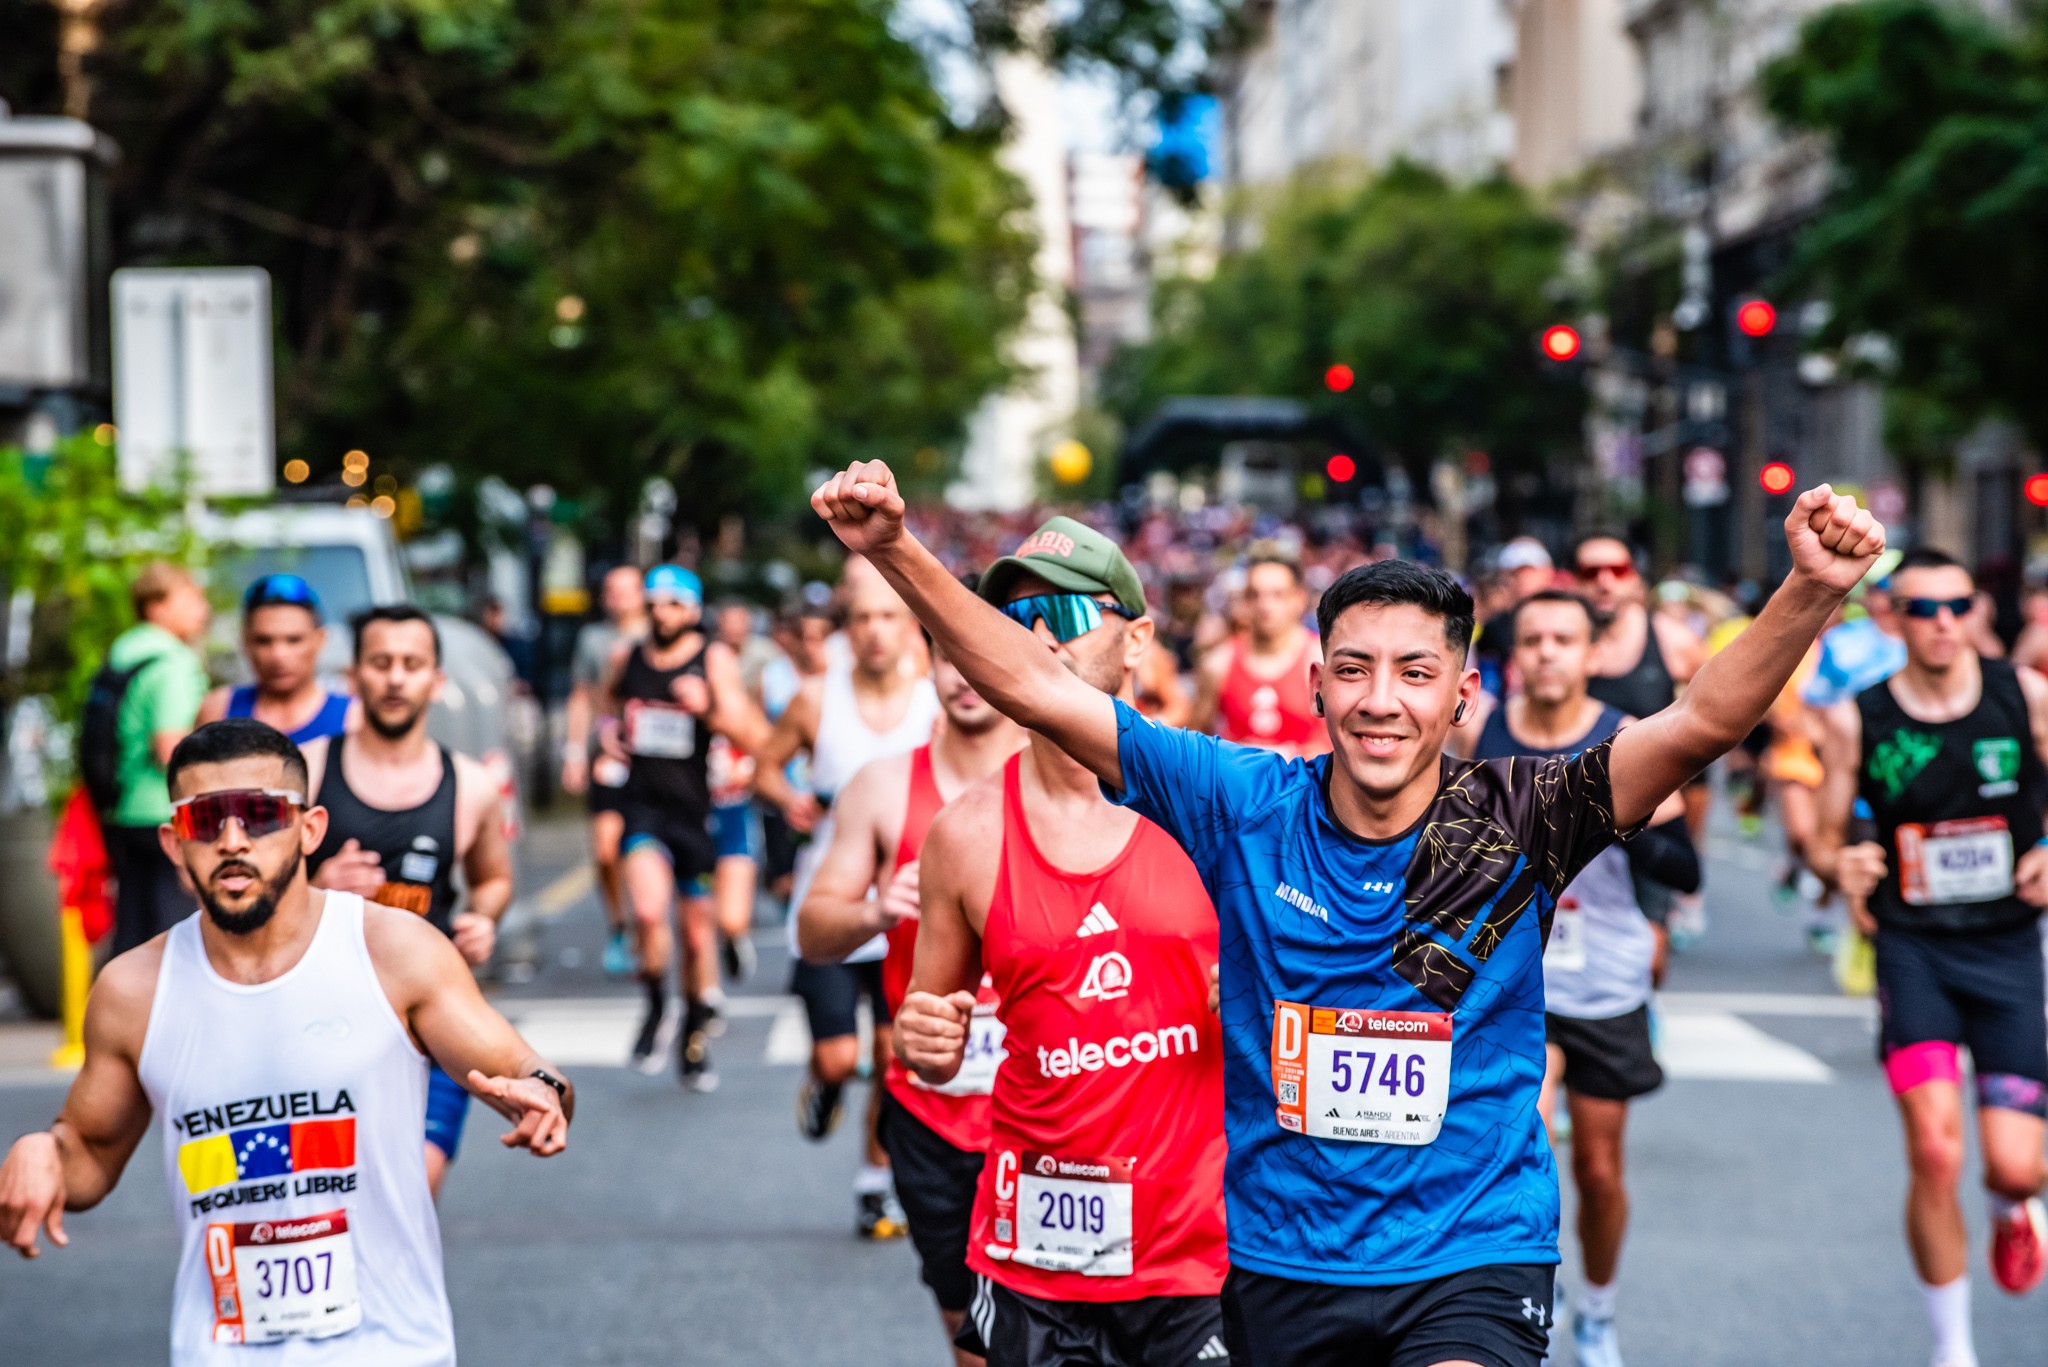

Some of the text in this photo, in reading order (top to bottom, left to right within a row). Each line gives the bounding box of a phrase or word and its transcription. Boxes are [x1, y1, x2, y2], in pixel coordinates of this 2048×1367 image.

[1279, 1007, 1302, 1060] D
[1367, 1017, 1429, 1033] telecom
[1037, 1024, 1198, 1078] telecom
[1331, 1049, 1426, 1097] 5746
[1333, 1126, 1359, 1137] BUENOS
[1360, 1127, 1380, 1139] AIRES
[294, 1173, 357, 1197] LIBRE
[996, 1150, 1016, 1200] C
[1059, 1161, 1110, 1178] telecom
[274, 1219, 332, 1240] telecom
[1038, 1191, 1105, 1234] 2019
[256, 1251, 332, 1299] 3707
